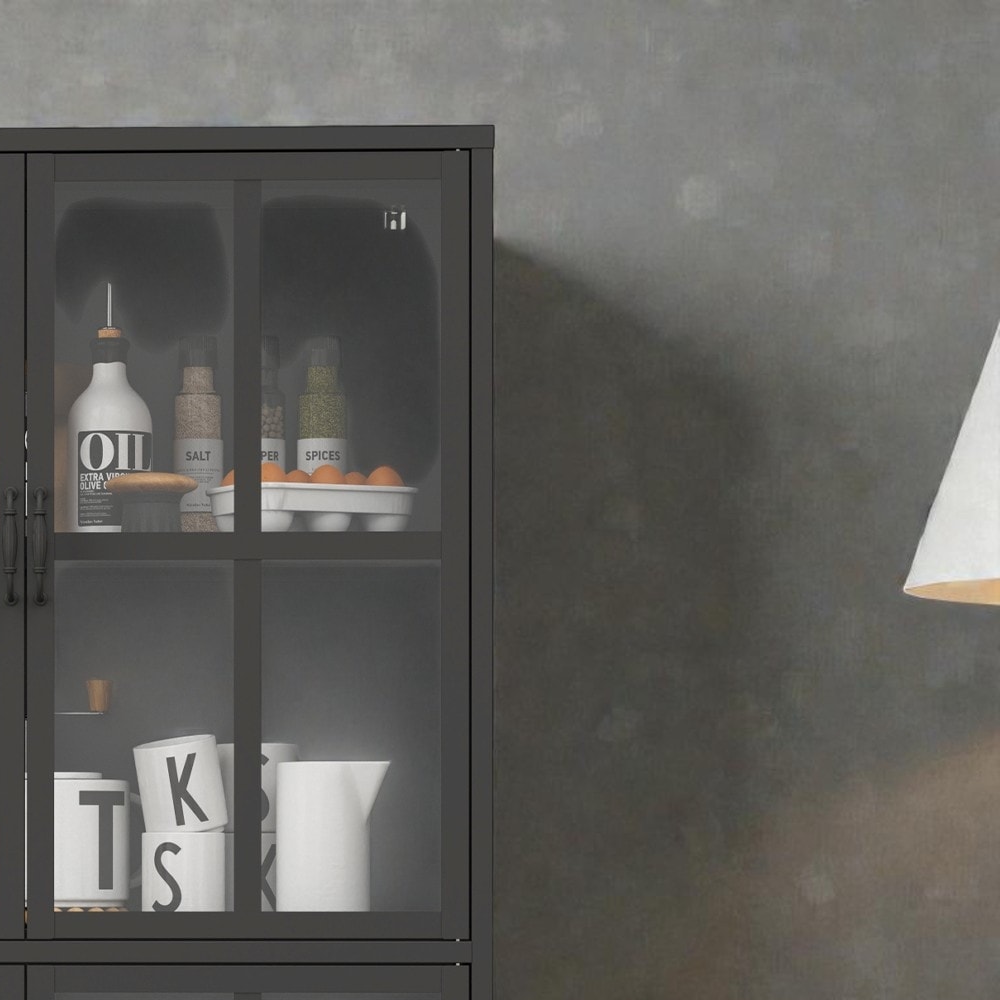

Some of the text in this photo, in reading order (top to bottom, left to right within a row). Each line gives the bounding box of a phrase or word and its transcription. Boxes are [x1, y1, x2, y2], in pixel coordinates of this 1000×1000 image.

[80, 432, 151, 471] OIL
[185, 450, 211, 461] SALT
[305, 450, 341, 461] SPICES
[80, 472, 104, 482] EXTRA
[80, 481, 101, 490] OLIVE
[166, 752, 209, 826] K
[79, 790, 125, 890] T
[152, 842, 182, 912] S
